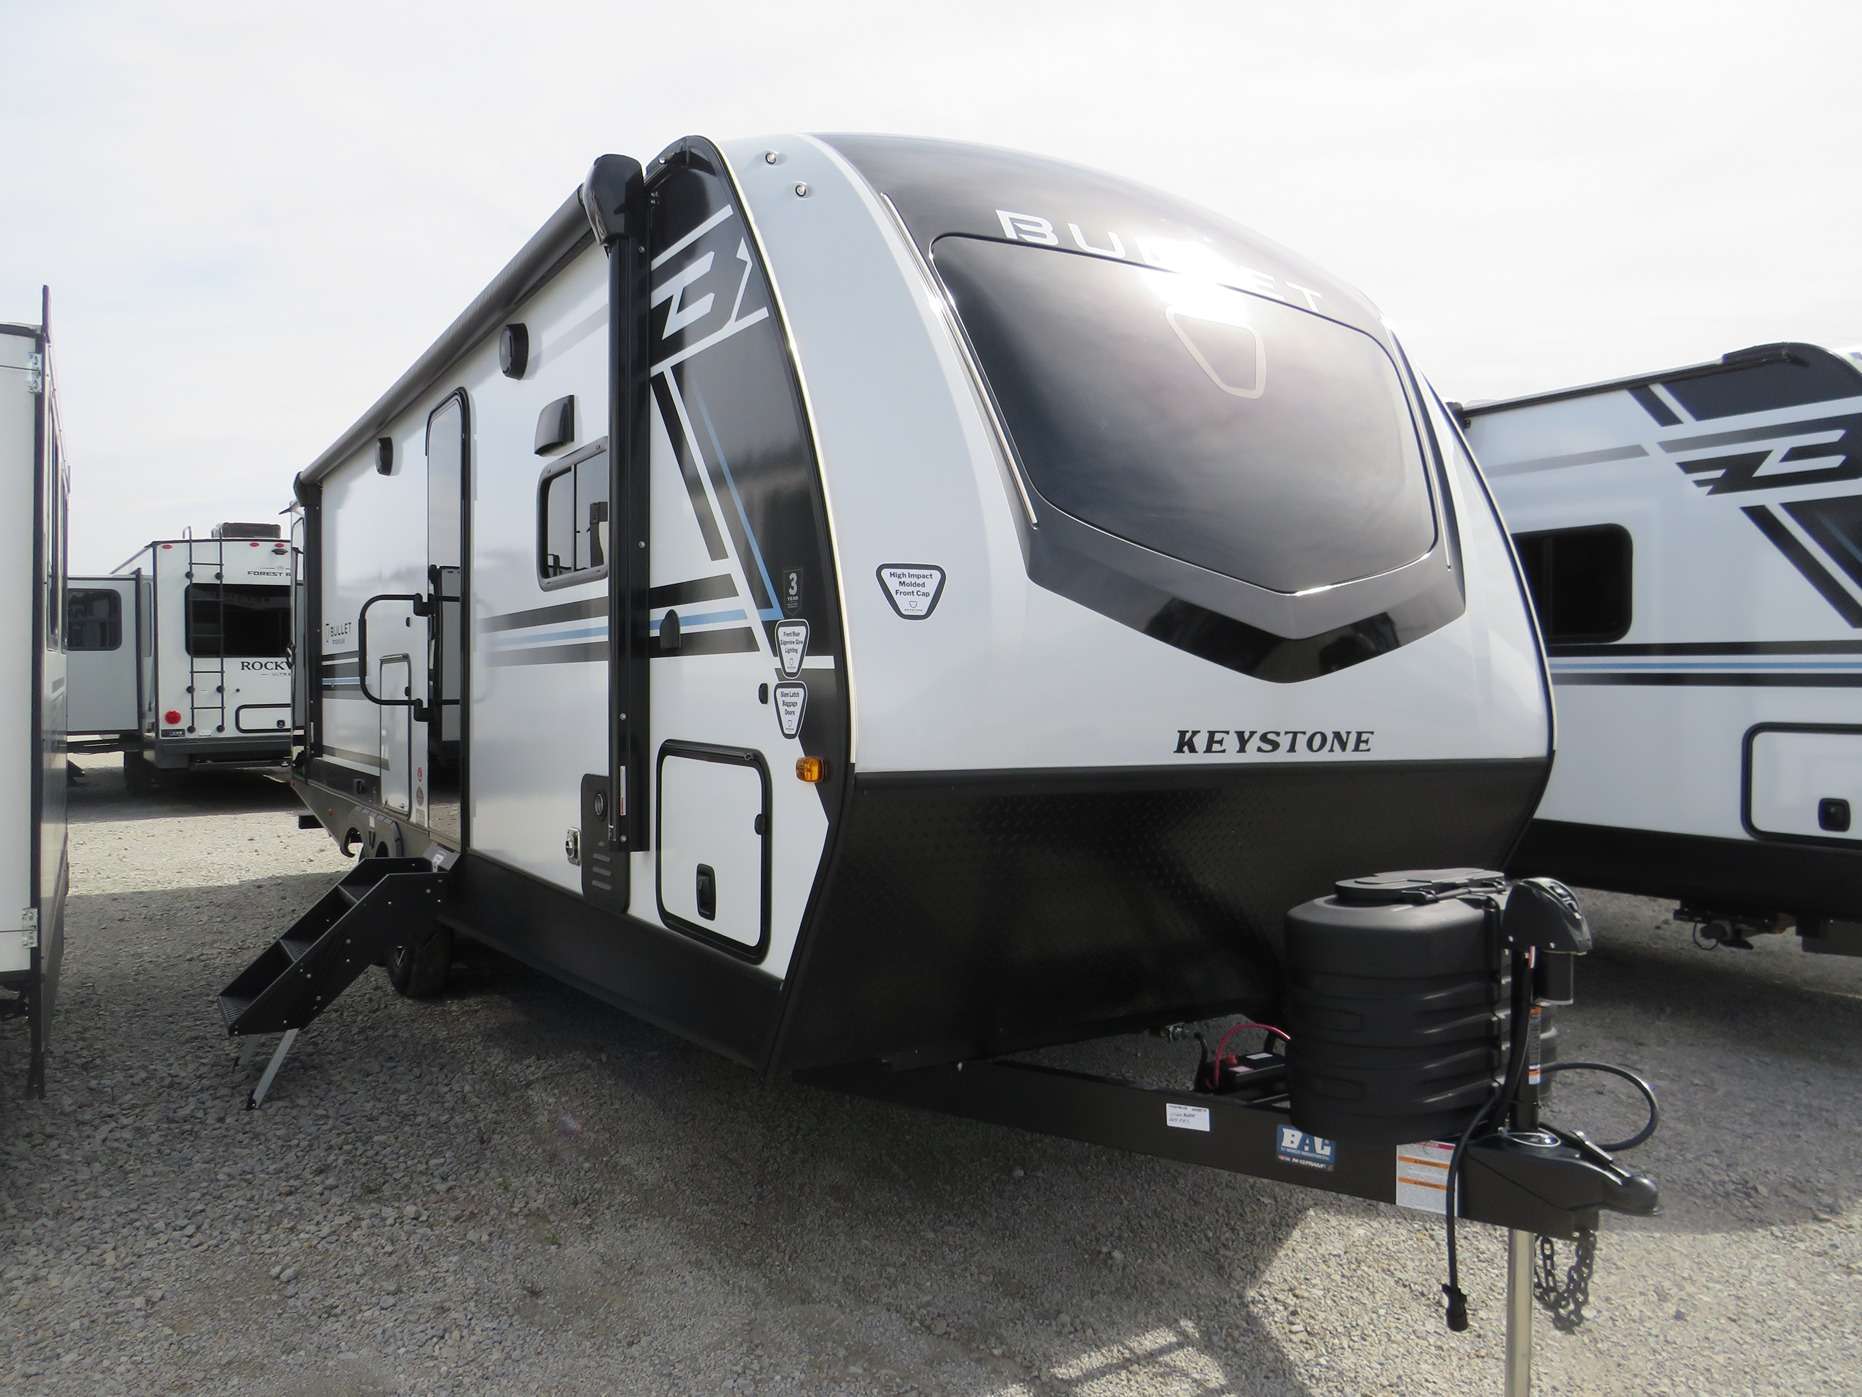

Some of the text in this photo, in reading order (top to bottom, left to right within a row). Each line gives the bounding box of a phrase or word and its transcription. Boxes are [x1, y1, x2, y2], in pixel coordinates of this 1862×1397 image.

[995, 209, 1322, 313] BUET
[788, 572, 798, 595] 3
[889, 571, 934, 580] High Impact
[895, 589, 931, 598] Front Cap
[330, 622, 352, 637] BULLET
[1173, 730, 1375, 754] KEYSTONE
